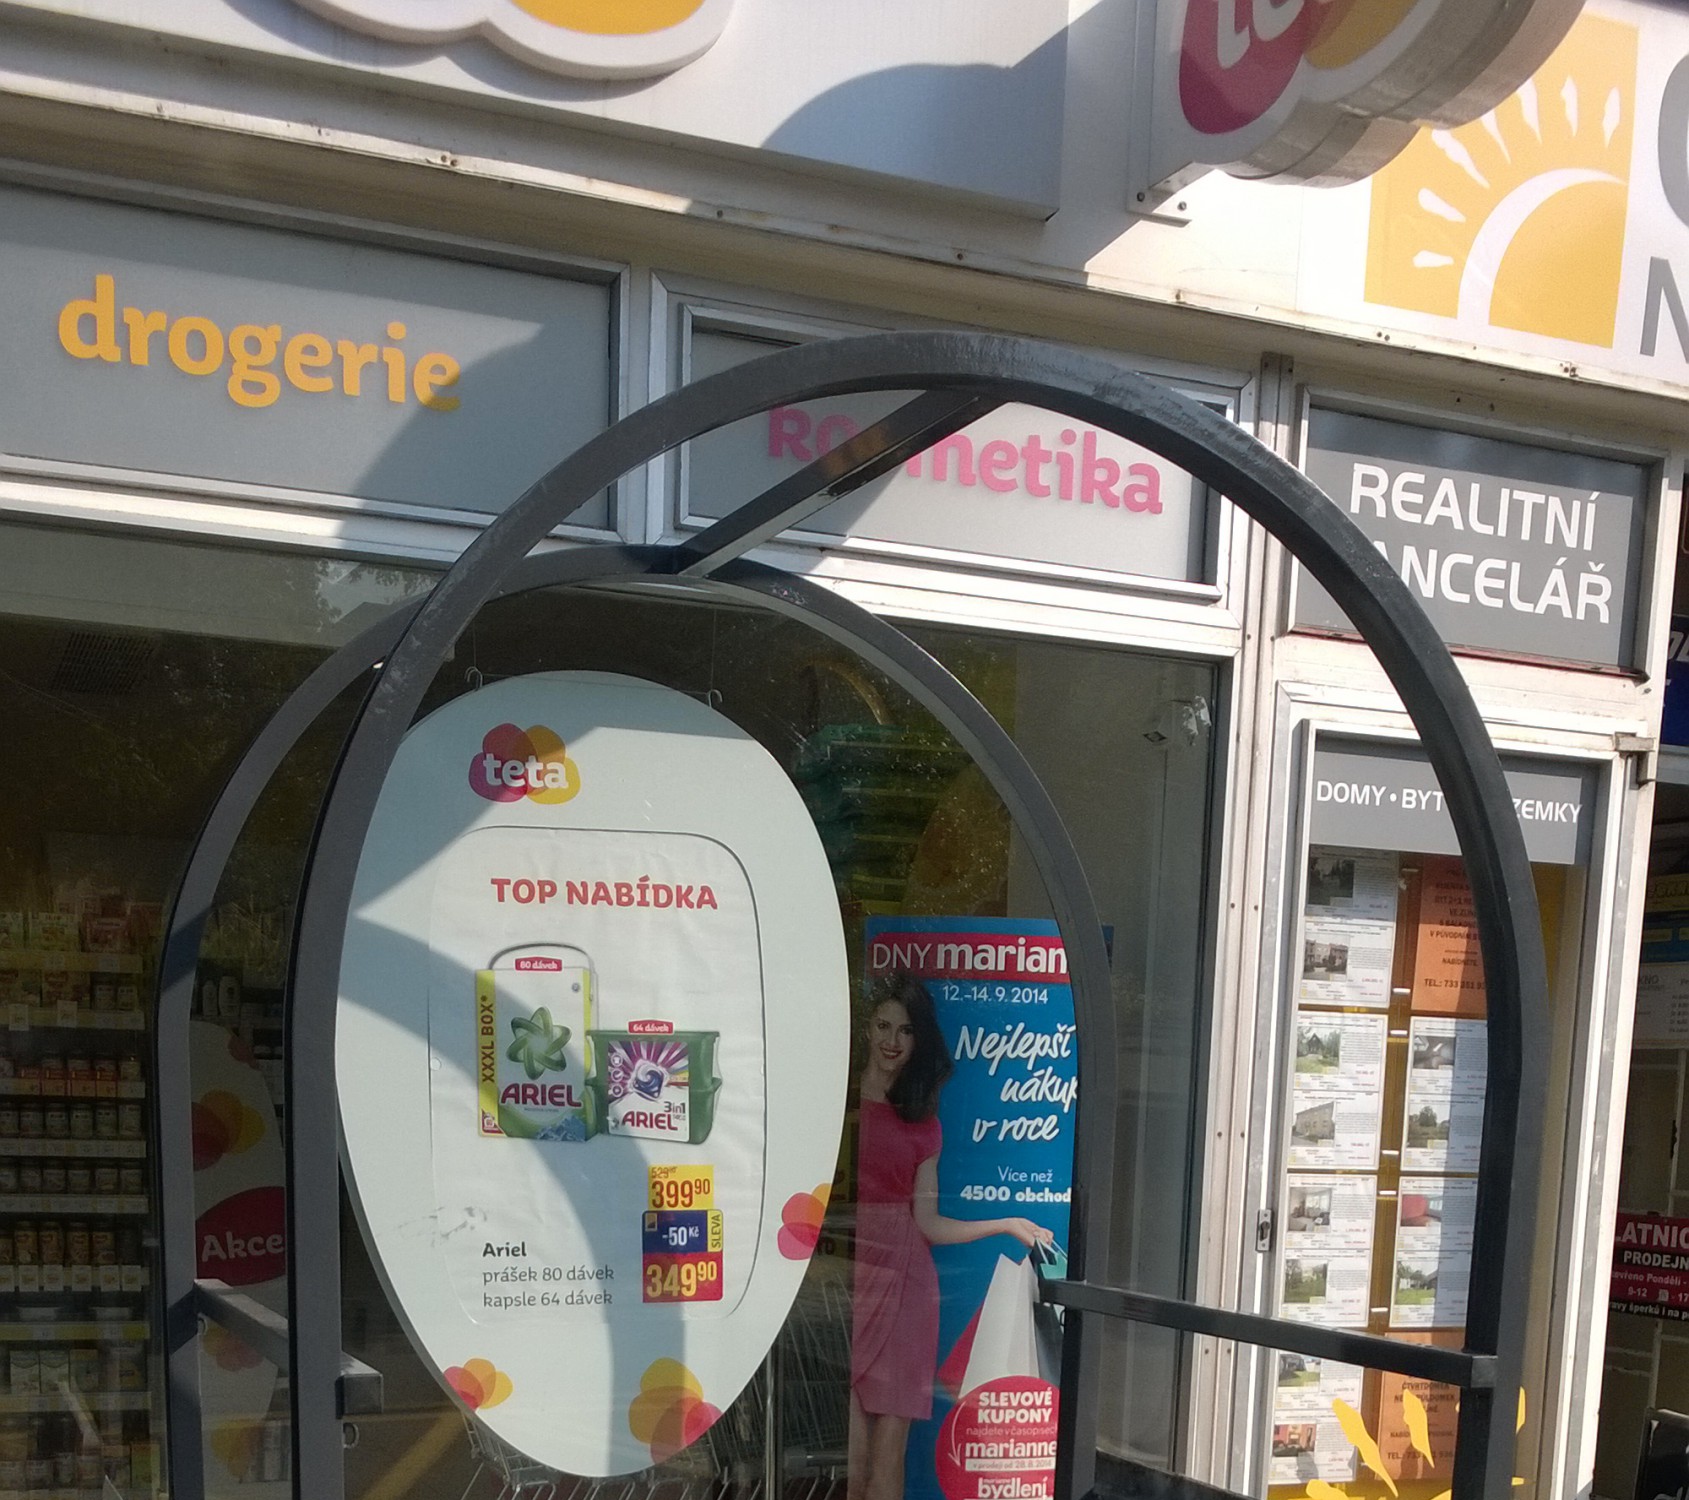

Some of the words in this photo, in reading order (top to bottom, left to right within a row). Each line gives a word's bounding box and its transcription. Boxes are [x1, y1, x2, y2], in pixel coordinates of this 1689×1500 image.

[58, 274, 461, 411] drogerie
[1350, 463, 1600, 551] REALITNÍ
[1372, 540, 1612, 624] NCELÁŘ
[482, 753, 569, 789] teta
[1316, 781, 1387, 807] DOMY
[1402, 789, 1443, 812] BYT
[1512, 798, 1582, 824] ZEMKY
[491, 878, 557, 904] TOP
[566, 874, 718, 910] NABÍDKA
[873, 943, 932, 969] DNY
[936, 937, 1068, 975] marian
[1011, 987, 1048, 1004] 2014
[954, 1022, 1077, 1076] Nejlepší
[481, 1040, 495, 1083] XXXL
[501, 1082, 582, 1107] ARIEL
[622, 1111, 678, 1131] ARIEL
[998, 1114, 1059, 1141] roce
[998, 1165, 1028, 1182] Více
[1030, 1169, 1053, 1183] než
[960, 1185, 1011, 1201] 4500
[1015, 1187, 1072, 1203] obchod
[711, 1213, 721, 1249] SLEVA
[202, 1231, 285, 1262] Akce
[482, 1241, 527, 1257] Ariel
[1623, 1250, 1689, 1270] PRODEJN
[483, 1266, 538, 1286] prášek
[542, 1267, 562, 1281] 80
[566, 1264, 614, 1281] dávek
[483, 1291, 536, 1310] kapsle
[541, 1292, 560, 1306] 64
[565, 1289, 613, 1306] dávek
[978, 1387, 1053, 1407] SLEVOVÉ
[977, 1408, 1053, 1424] KUPONY
[966, 1425, 1004, 1437] najdete
[965, 1438, 1058, 1457] marianne
[977, 1476, 1048, 1499] bydlení
